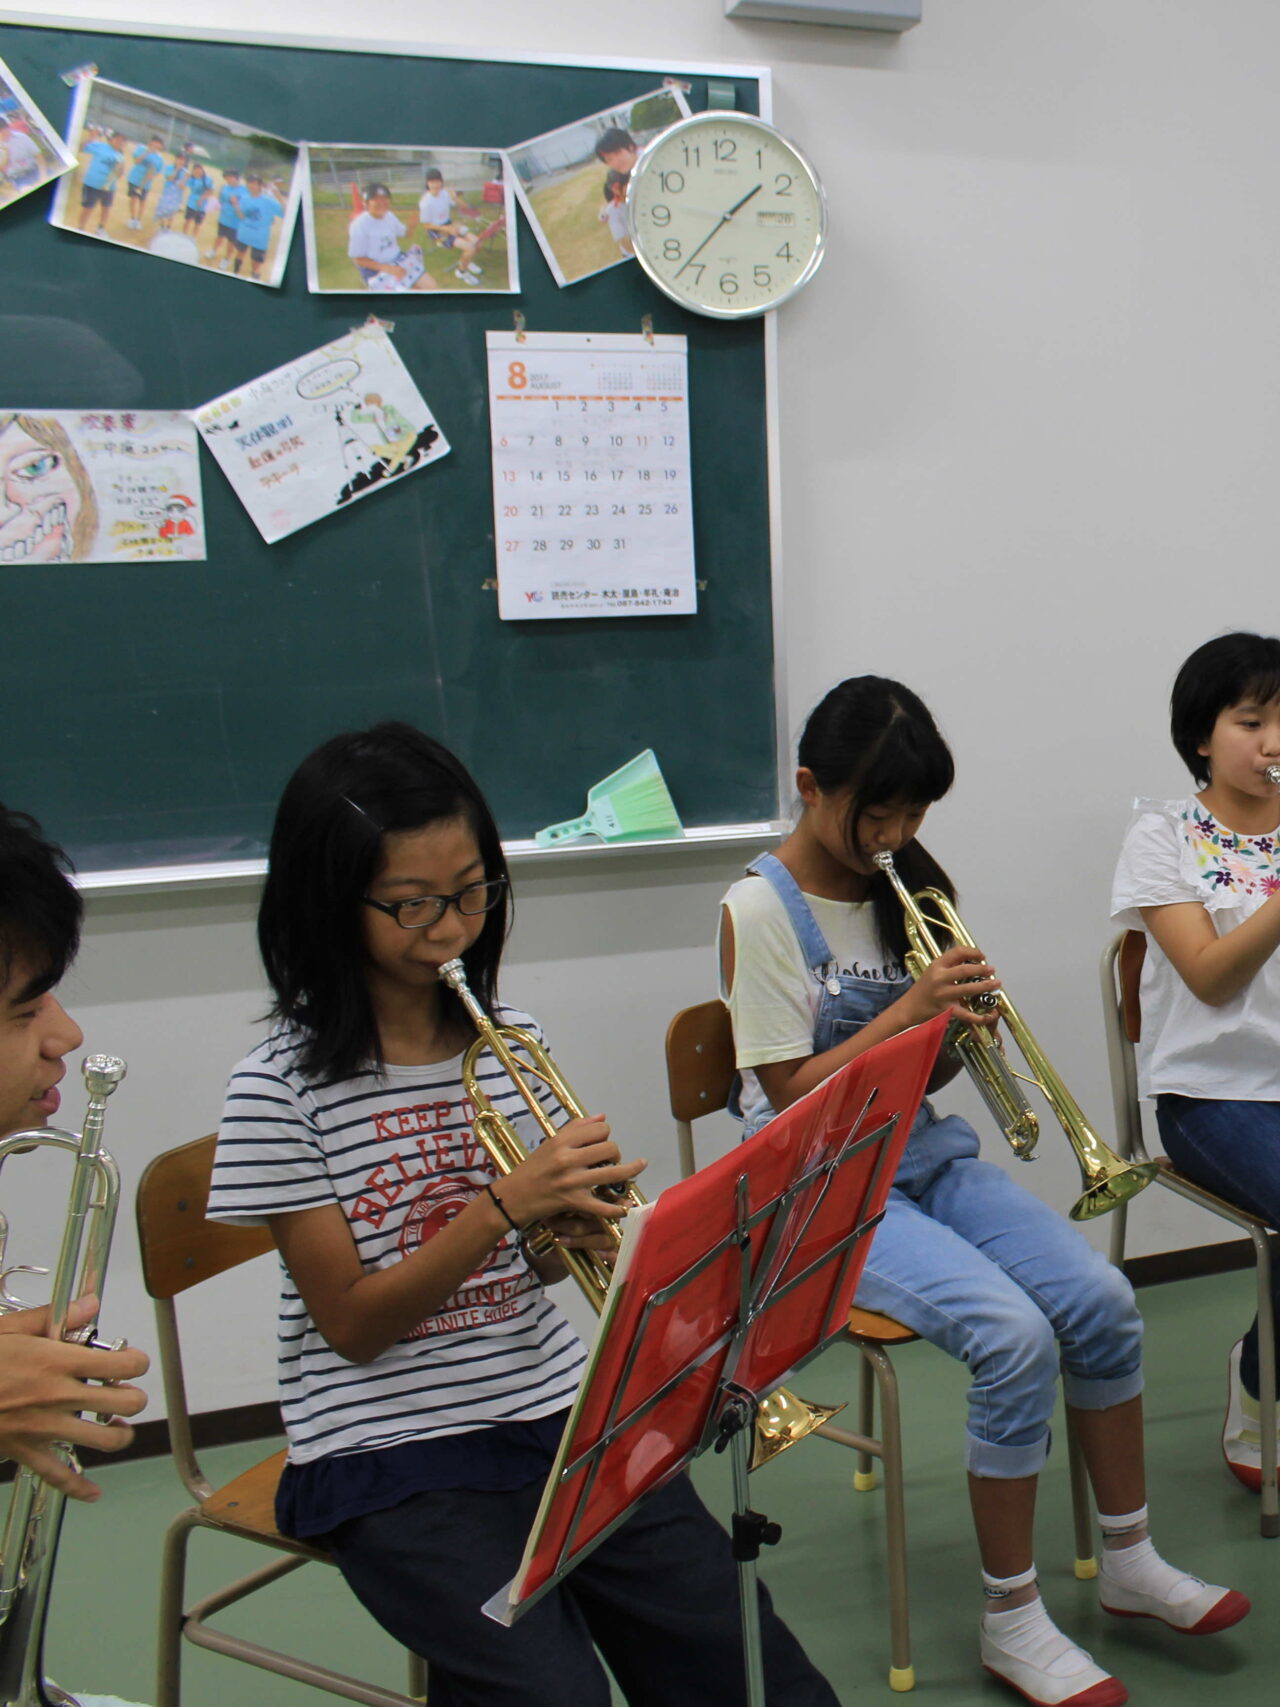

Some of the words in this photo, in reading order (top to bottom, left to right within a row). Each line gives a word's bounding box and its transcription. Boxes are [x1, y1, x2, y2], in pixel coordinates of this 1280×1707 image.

[682, 145, 701, 168] 11
[712, 138, 738, 162] 12
[755, 148, 763, 171] 1
[659, 170, 686, 194] 10
[774, 173, 793, 197] 2
[651, 204, 672, 227] 9
[662, 238, 682, 262] 8
[775, 241, 794, 264] 4
[687, 263, 706, 286] 7
[718, 272, 740, 295] 6
[752, 264, 772, 288] 5
[508, 361, 528, 390] 8
[610, 436, 623, 447] 10
[637, 436, 648, 447] 11
[664, 436, 675, 447] 12
[503, 471, 516, 482] 13
[530, 470, 543, 481] 14
[558, 470, 570, 481] 15
[585, 470, 597, 481] 16
[612, 470, 623, 481] 17
[638, 470, 651, 480] 18
[665, 470, 677, 480] 19
[503, 506, 518, 517] 20
[531, 505, 543, 516] 21
[558, 505, 571, 516] 22
[585, 504, 599, 516] 23
[612, 504, 626, 515] 24
[638, 504, 652, 515] 25
[664, 503, 678, 514] 26
[505, 540, 519, 552] 27
[533, 540, 547, 551] 28
[560, 539, 574, 551] 29
[587, 539, 600, 550] 30
[614, 538, 626, 550] 31
[370, 1100, 451, 1142] KEEP
[350, 1131, 496, 1230] BELIEV
[407, 1309, 480, 1343] NFINITE
